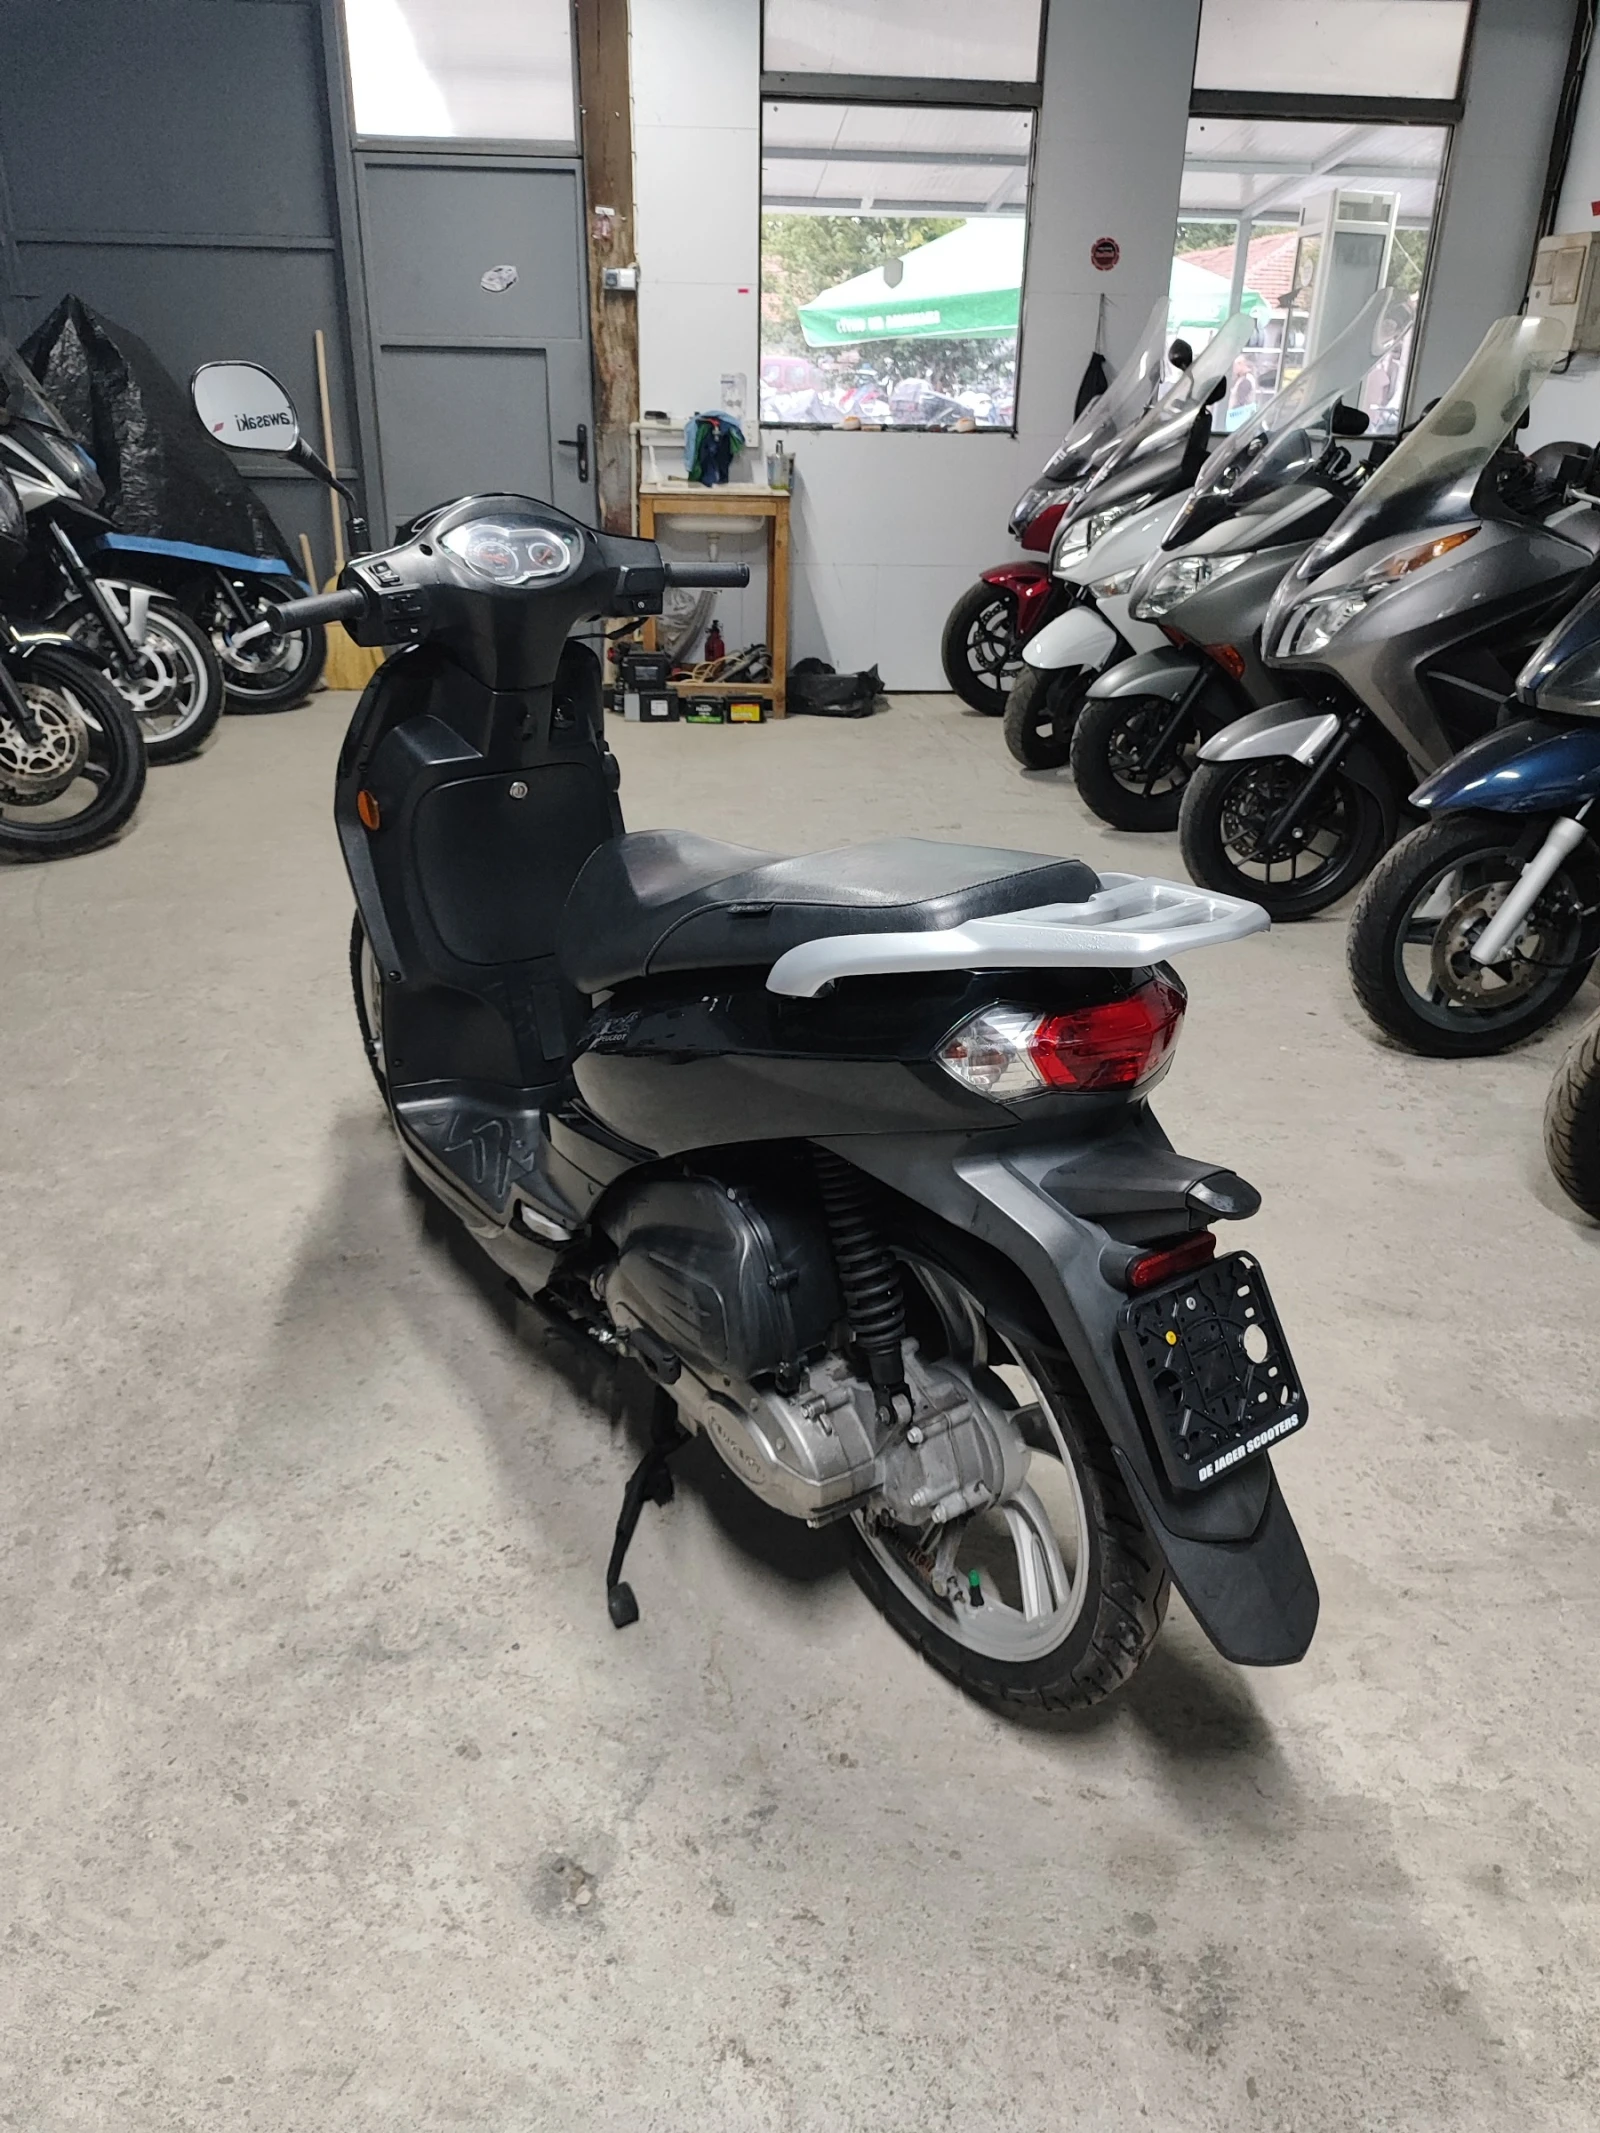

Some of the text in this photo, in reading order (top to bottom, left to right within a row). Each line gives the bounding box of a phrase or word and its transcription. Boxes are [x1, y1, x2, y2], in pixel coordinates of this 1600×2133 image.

[1198, 1413, 1299, 1482] DE JAGER SCOOTERS
